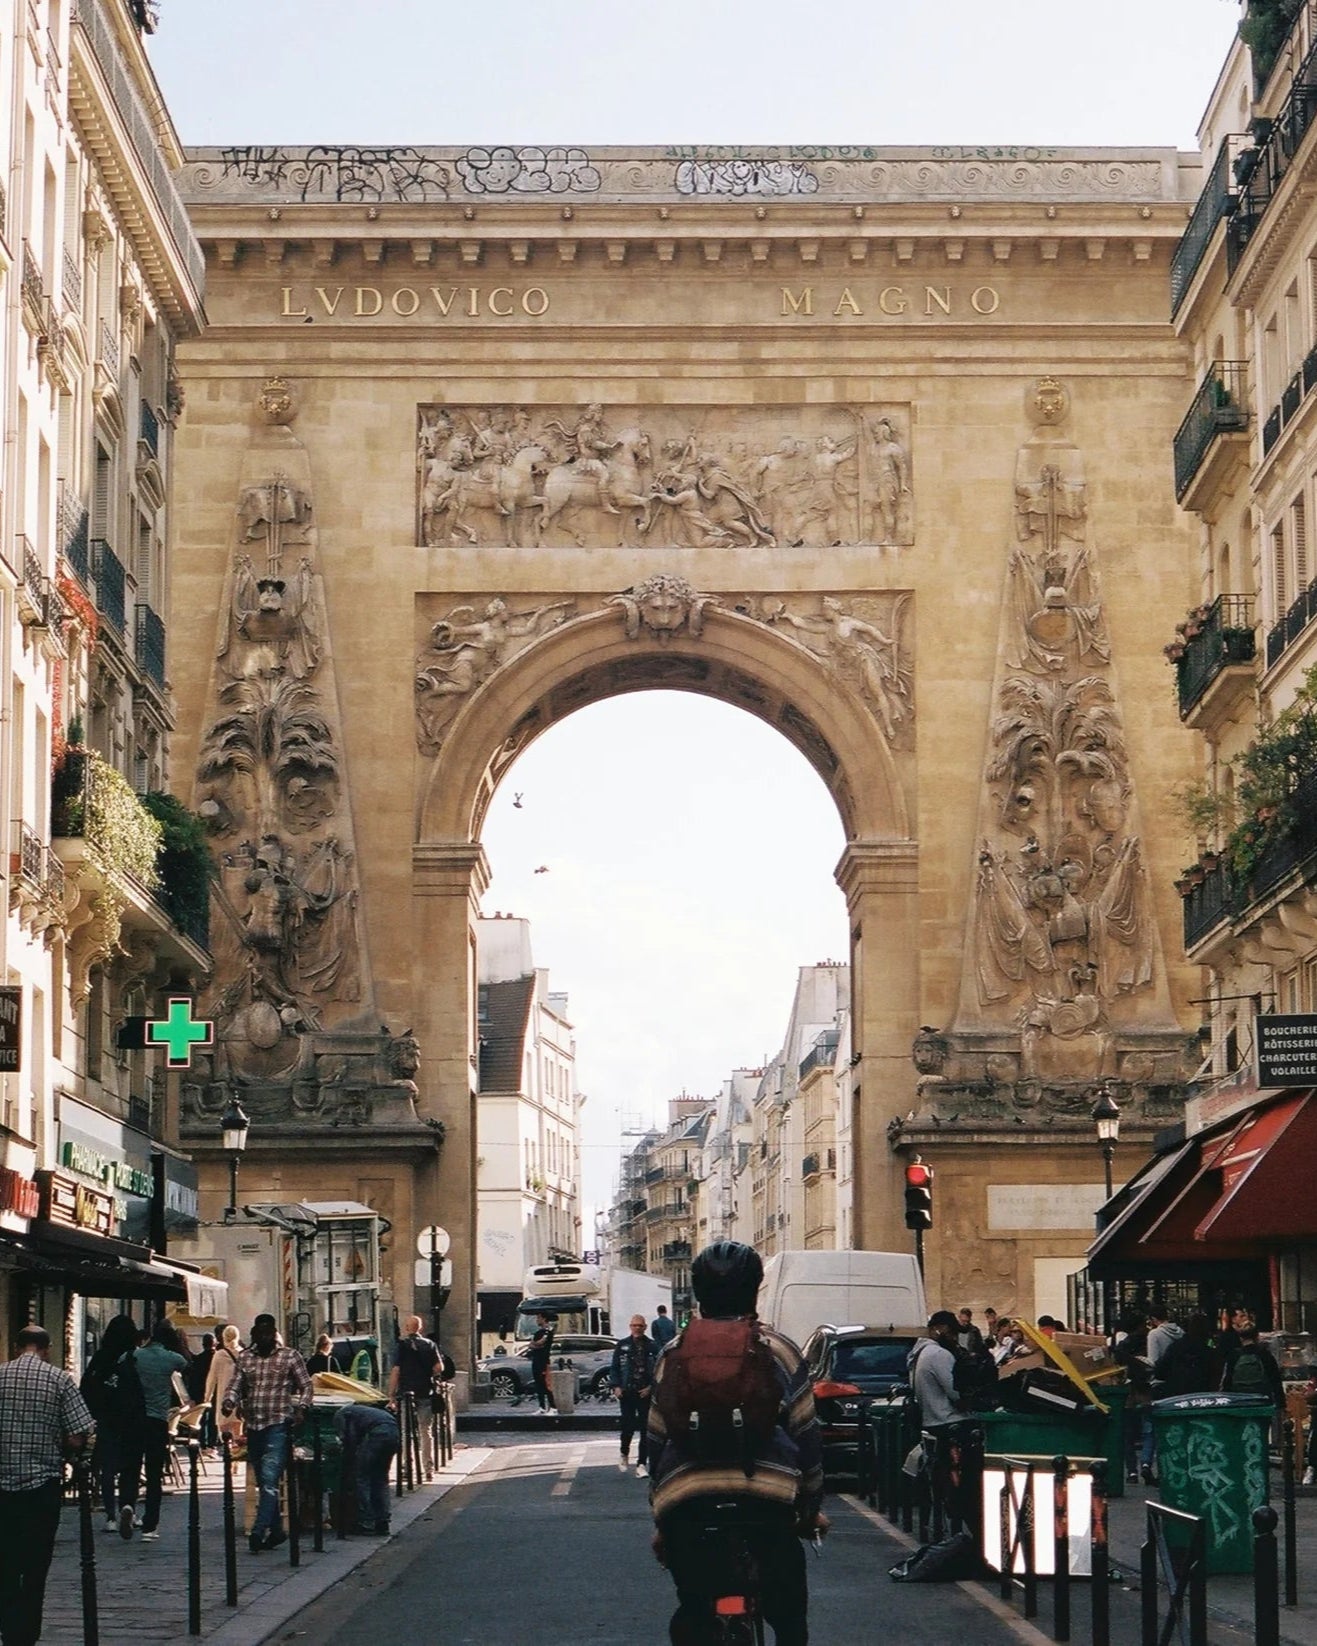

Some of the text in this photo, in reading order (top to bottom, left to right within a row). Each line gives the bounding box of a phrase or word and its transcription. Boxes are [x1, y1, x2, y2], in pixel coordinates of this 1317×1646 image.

[281, 286, 1000, 316] LVDOVICO MAGNO
[1263, 1026, 1317, 1036] BOUCHERIE
